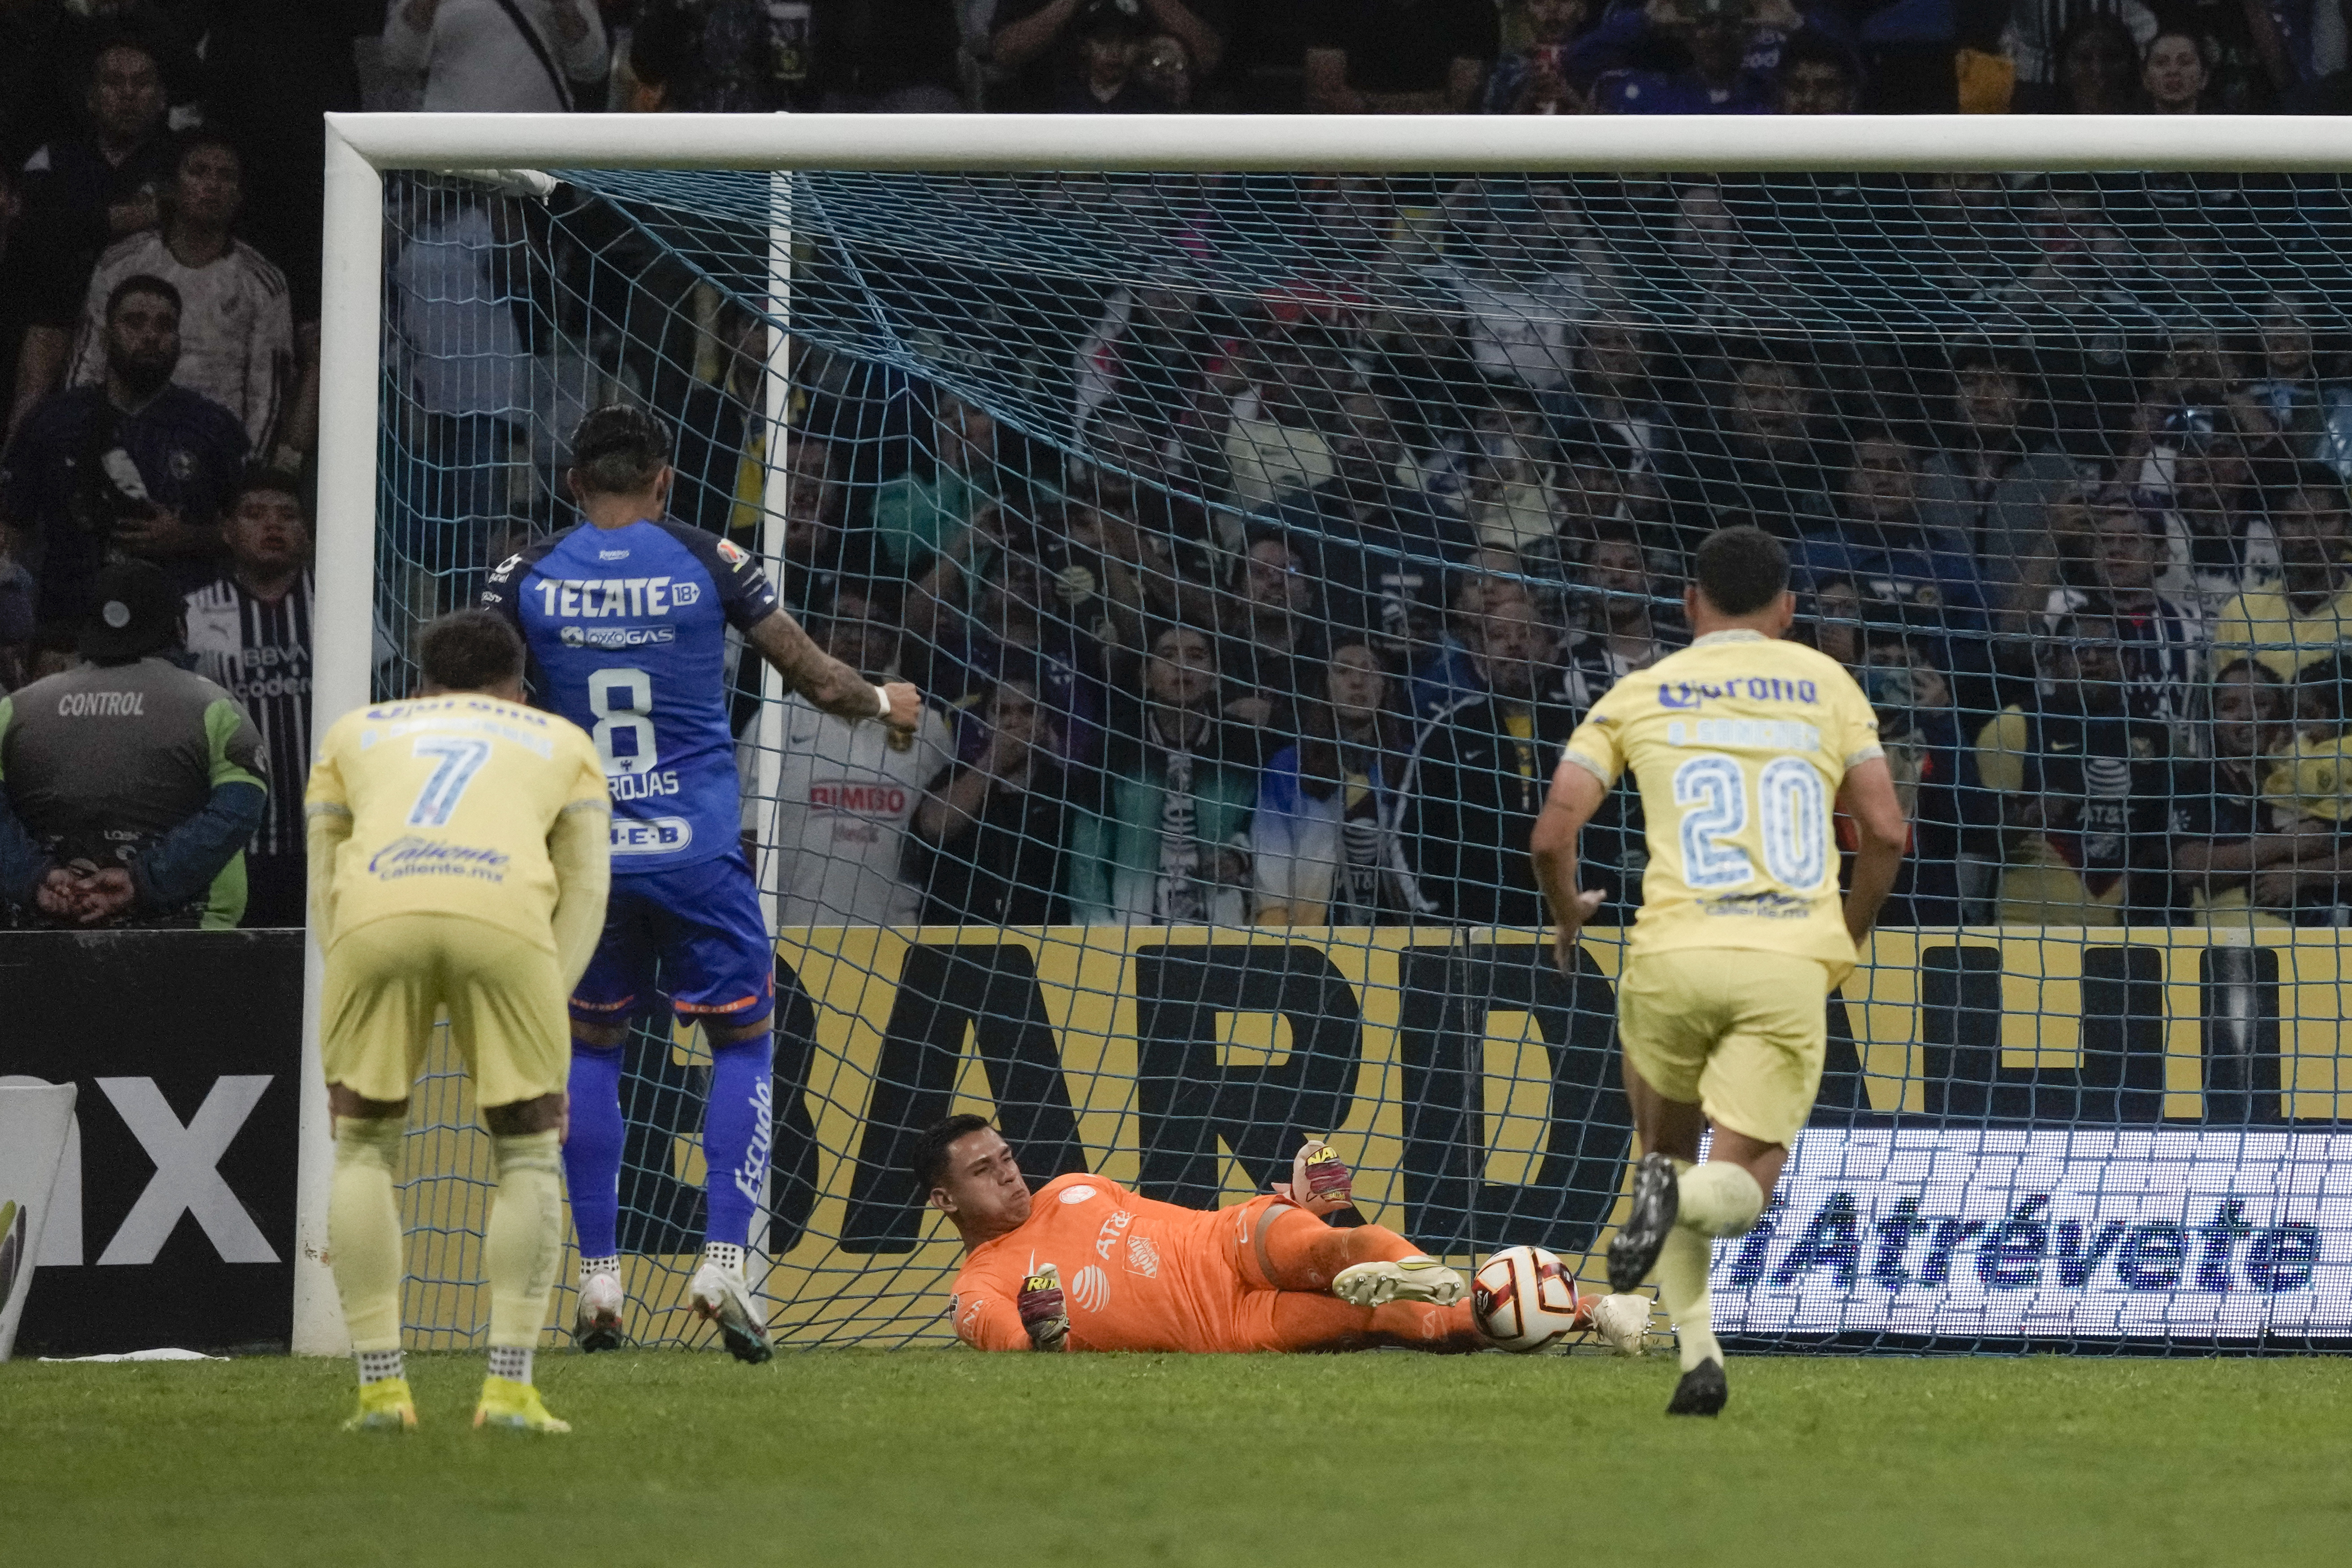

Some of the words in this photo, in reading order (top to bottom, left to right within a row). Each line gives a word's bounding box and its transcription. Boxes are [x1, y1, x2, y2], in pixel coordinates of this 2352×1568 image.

[535, 576, 671, 618] TECATE
[674, 584, 699, 604] 18+
[243, 644, 309, 667] BBVA
[237, 671, 312, 698] coder
[1658, 678, 1820, 709] Corona
[59, 691, 144, 717] CONTROL
[588, 668, 658, 777] 8
[407, 736, 492, 828] 7
[608, 771, 679, 801] ROJAS
[811, 787, 905, 813] BIMBO
[1672, 753, 1827, 890] 20
[621, 943, 2281, 1256] BARDH
[734, 1081, 772, 1206] Escudo
